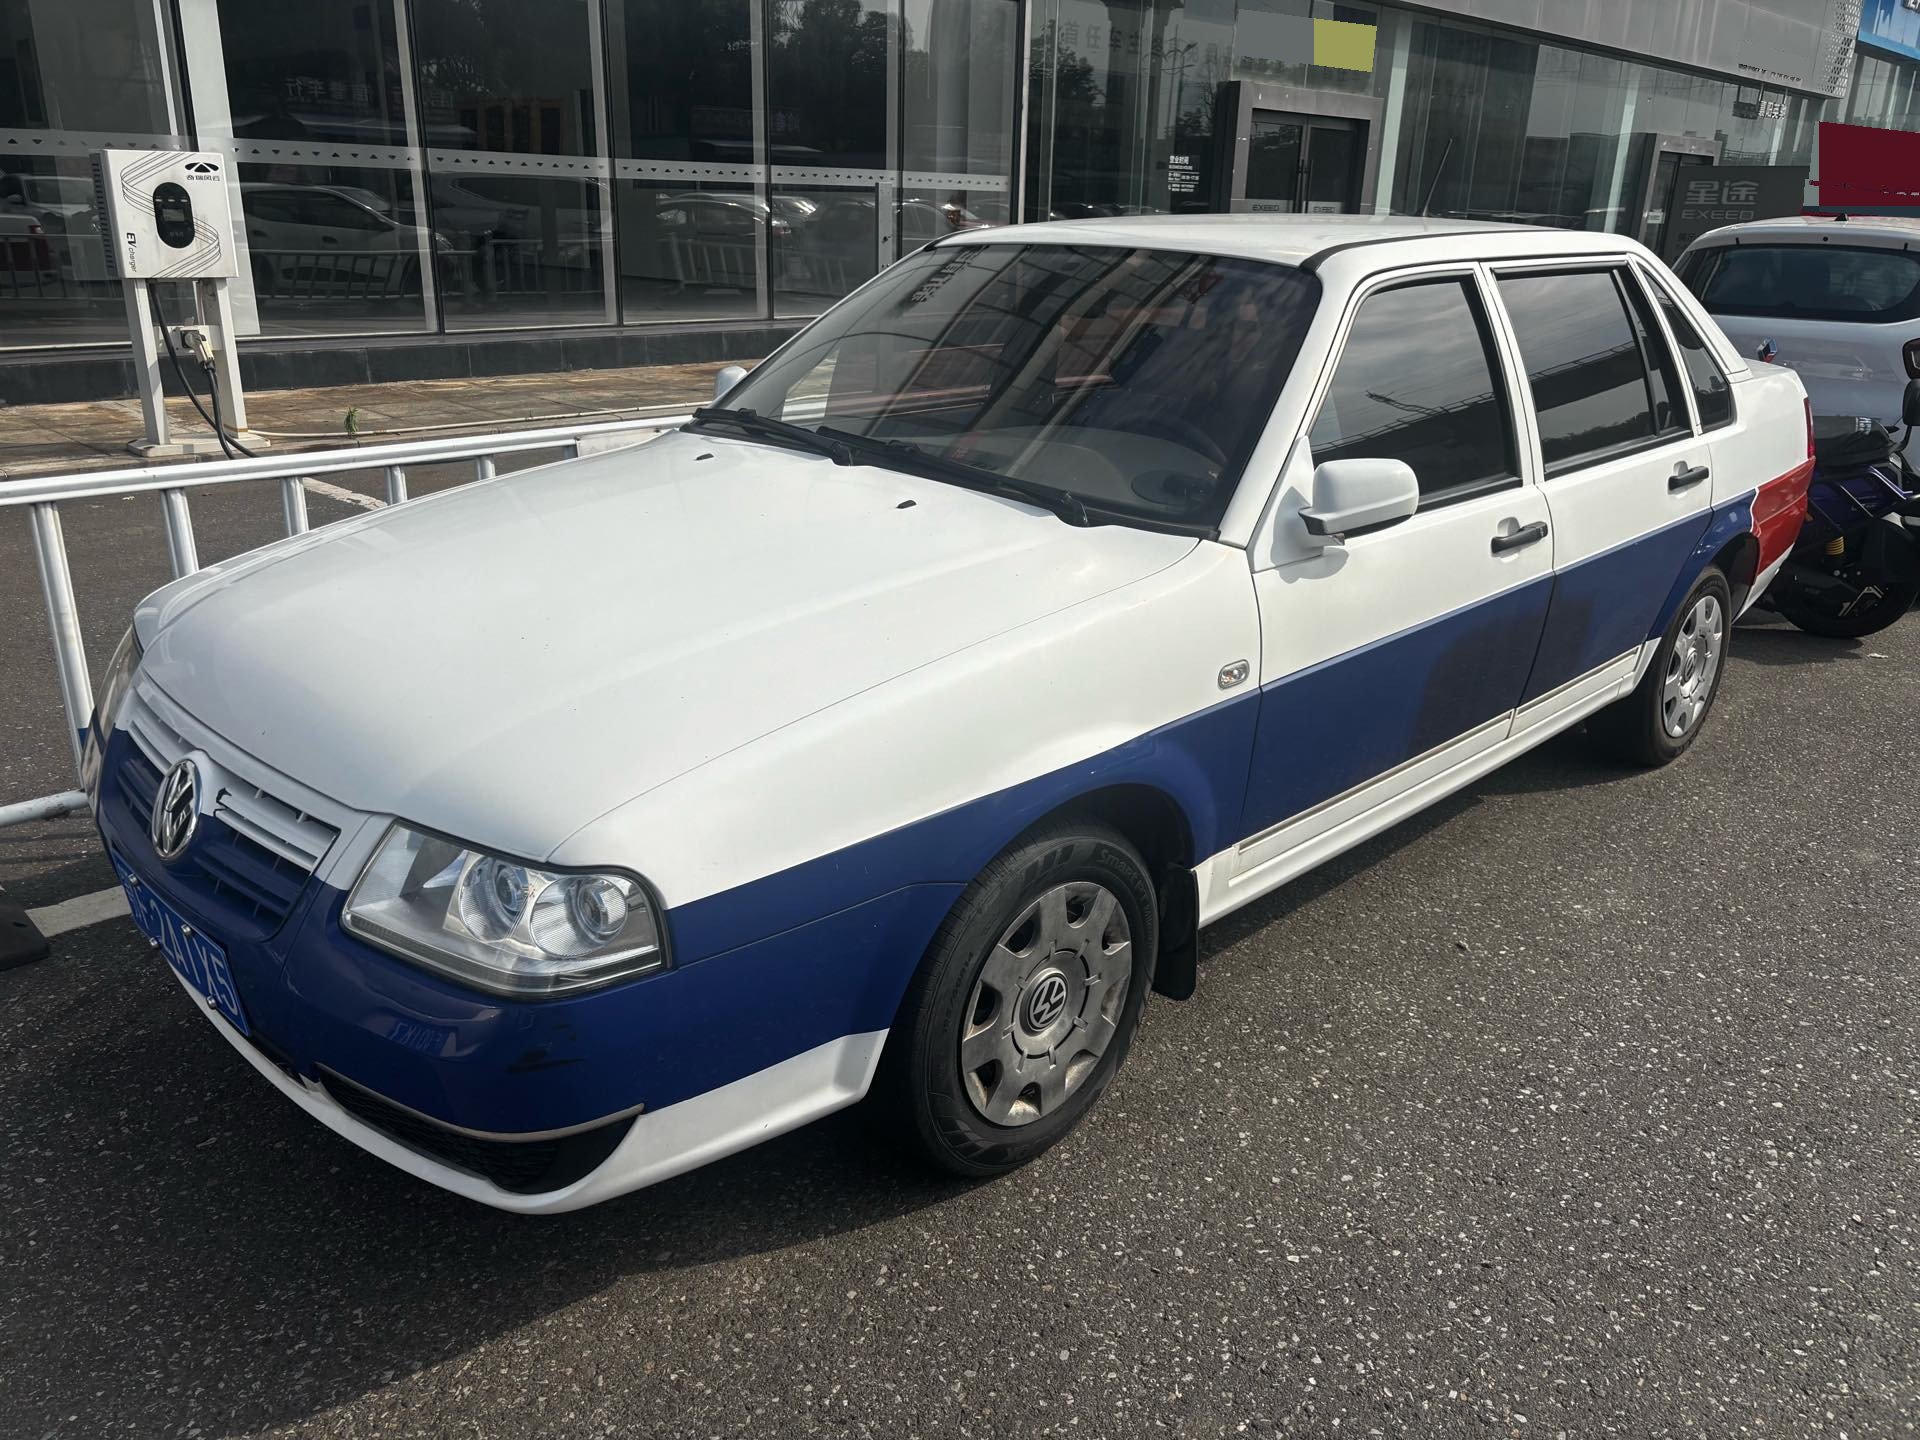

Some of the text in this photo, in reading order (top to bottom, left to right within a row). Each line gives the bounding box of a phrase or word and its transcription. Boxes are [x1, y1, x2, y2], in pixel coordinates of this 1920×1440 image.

[1684, 180, 1760, 205] 星途
[1681, 209, 1756, 221] EXEED
[126, 232, 137, 272] EV charger
